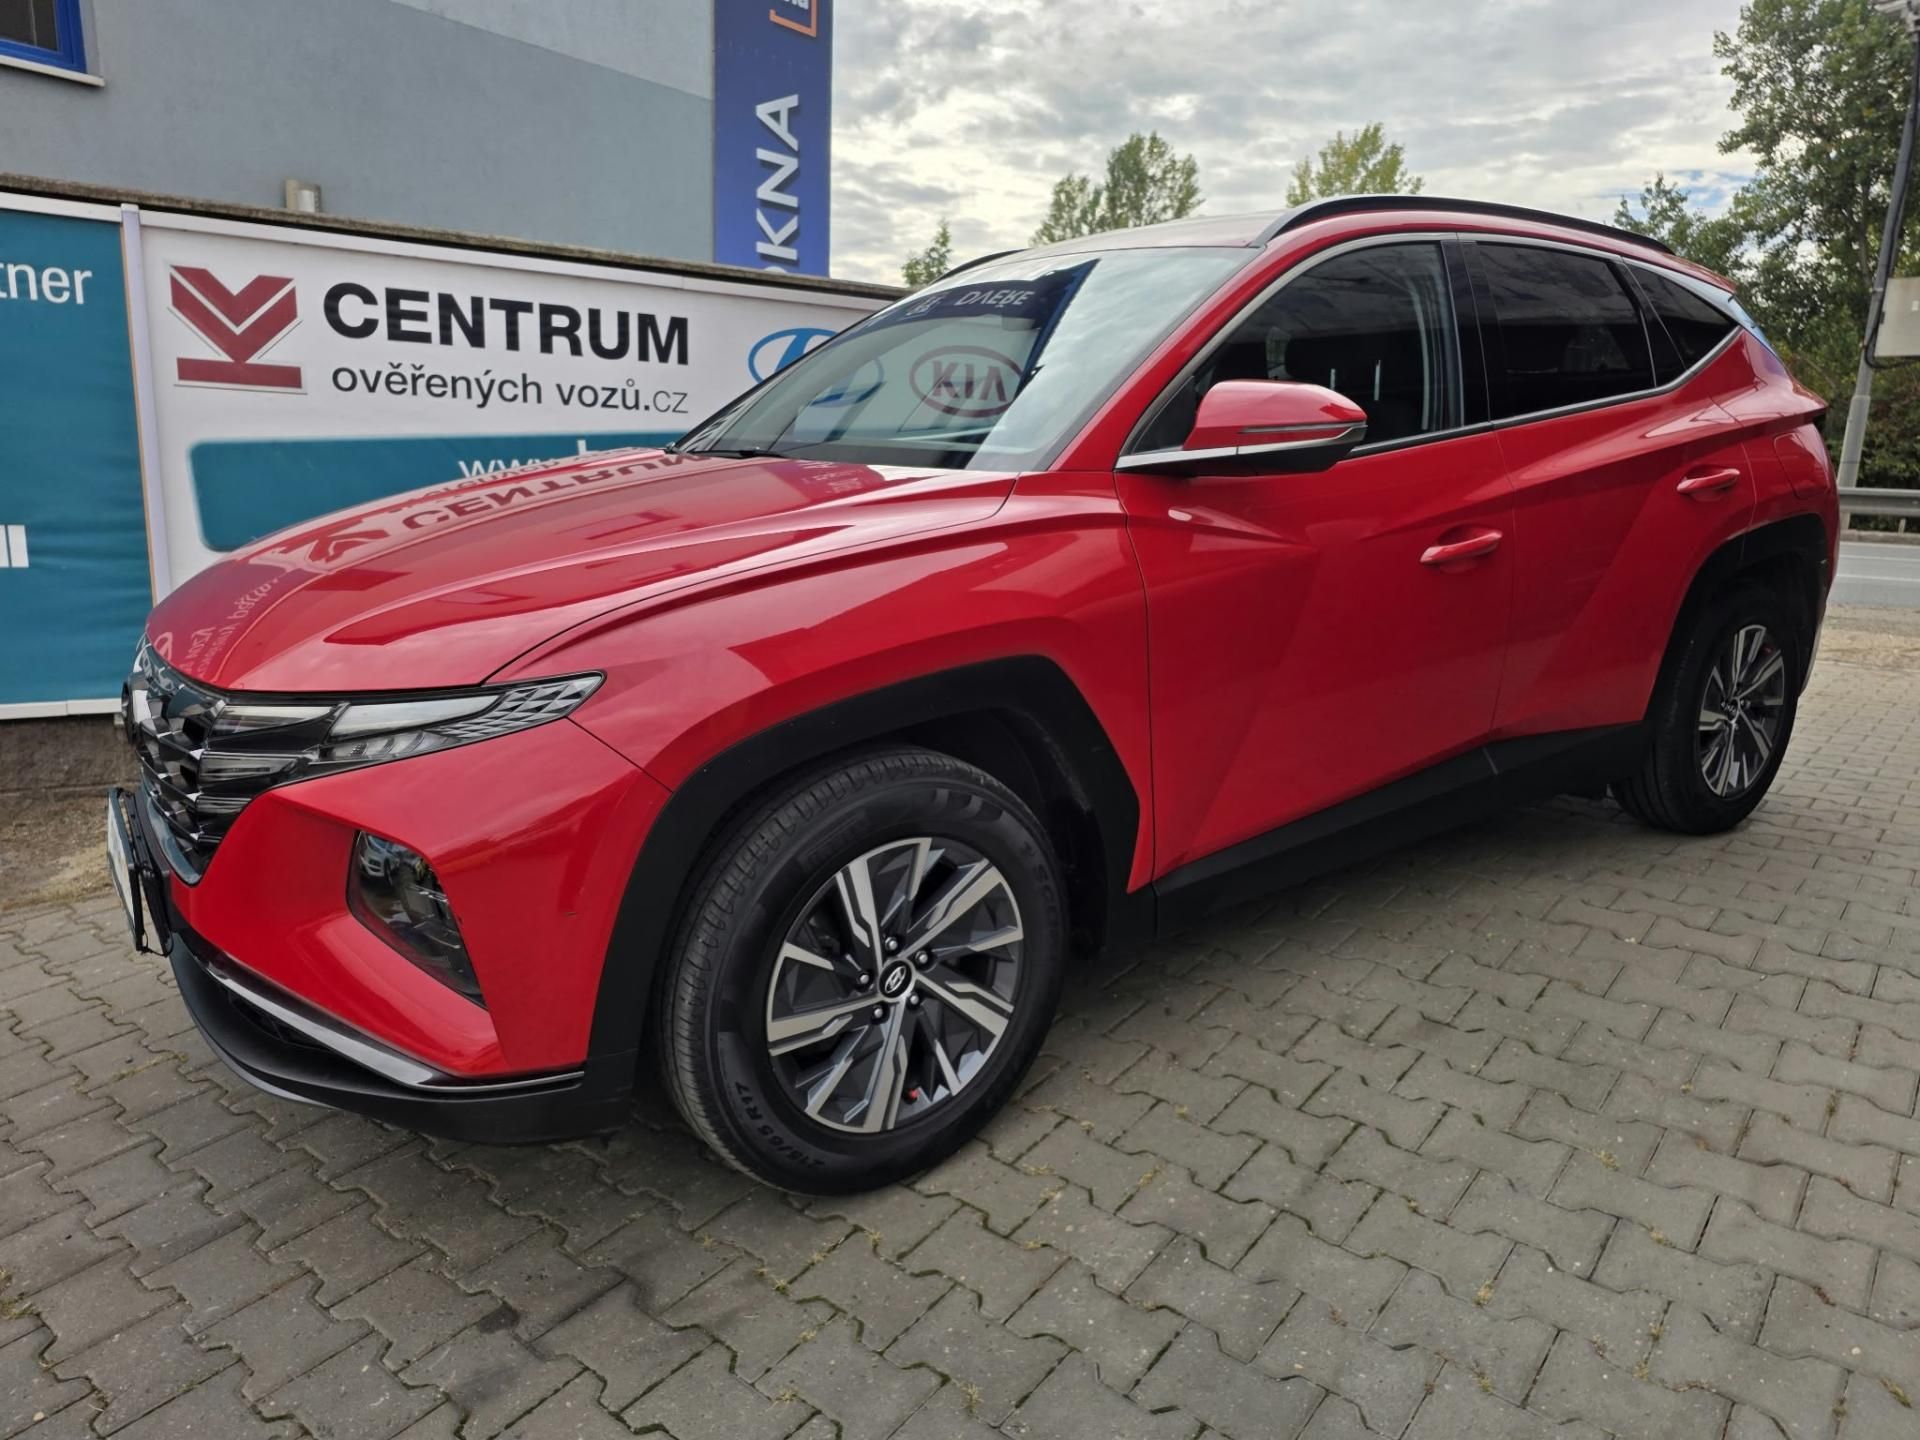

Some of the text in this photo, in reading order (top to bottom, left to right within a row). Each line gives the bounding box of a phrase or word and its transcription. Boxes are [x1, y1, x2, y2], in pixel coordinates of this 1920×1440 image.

[756, 93, 799, 274] KNA
[323, 282, 689, 366] CENTRUM
[331, 362, 689, 414] ověřených vozů.cz
[931, 358, 1008, 402] KIA
